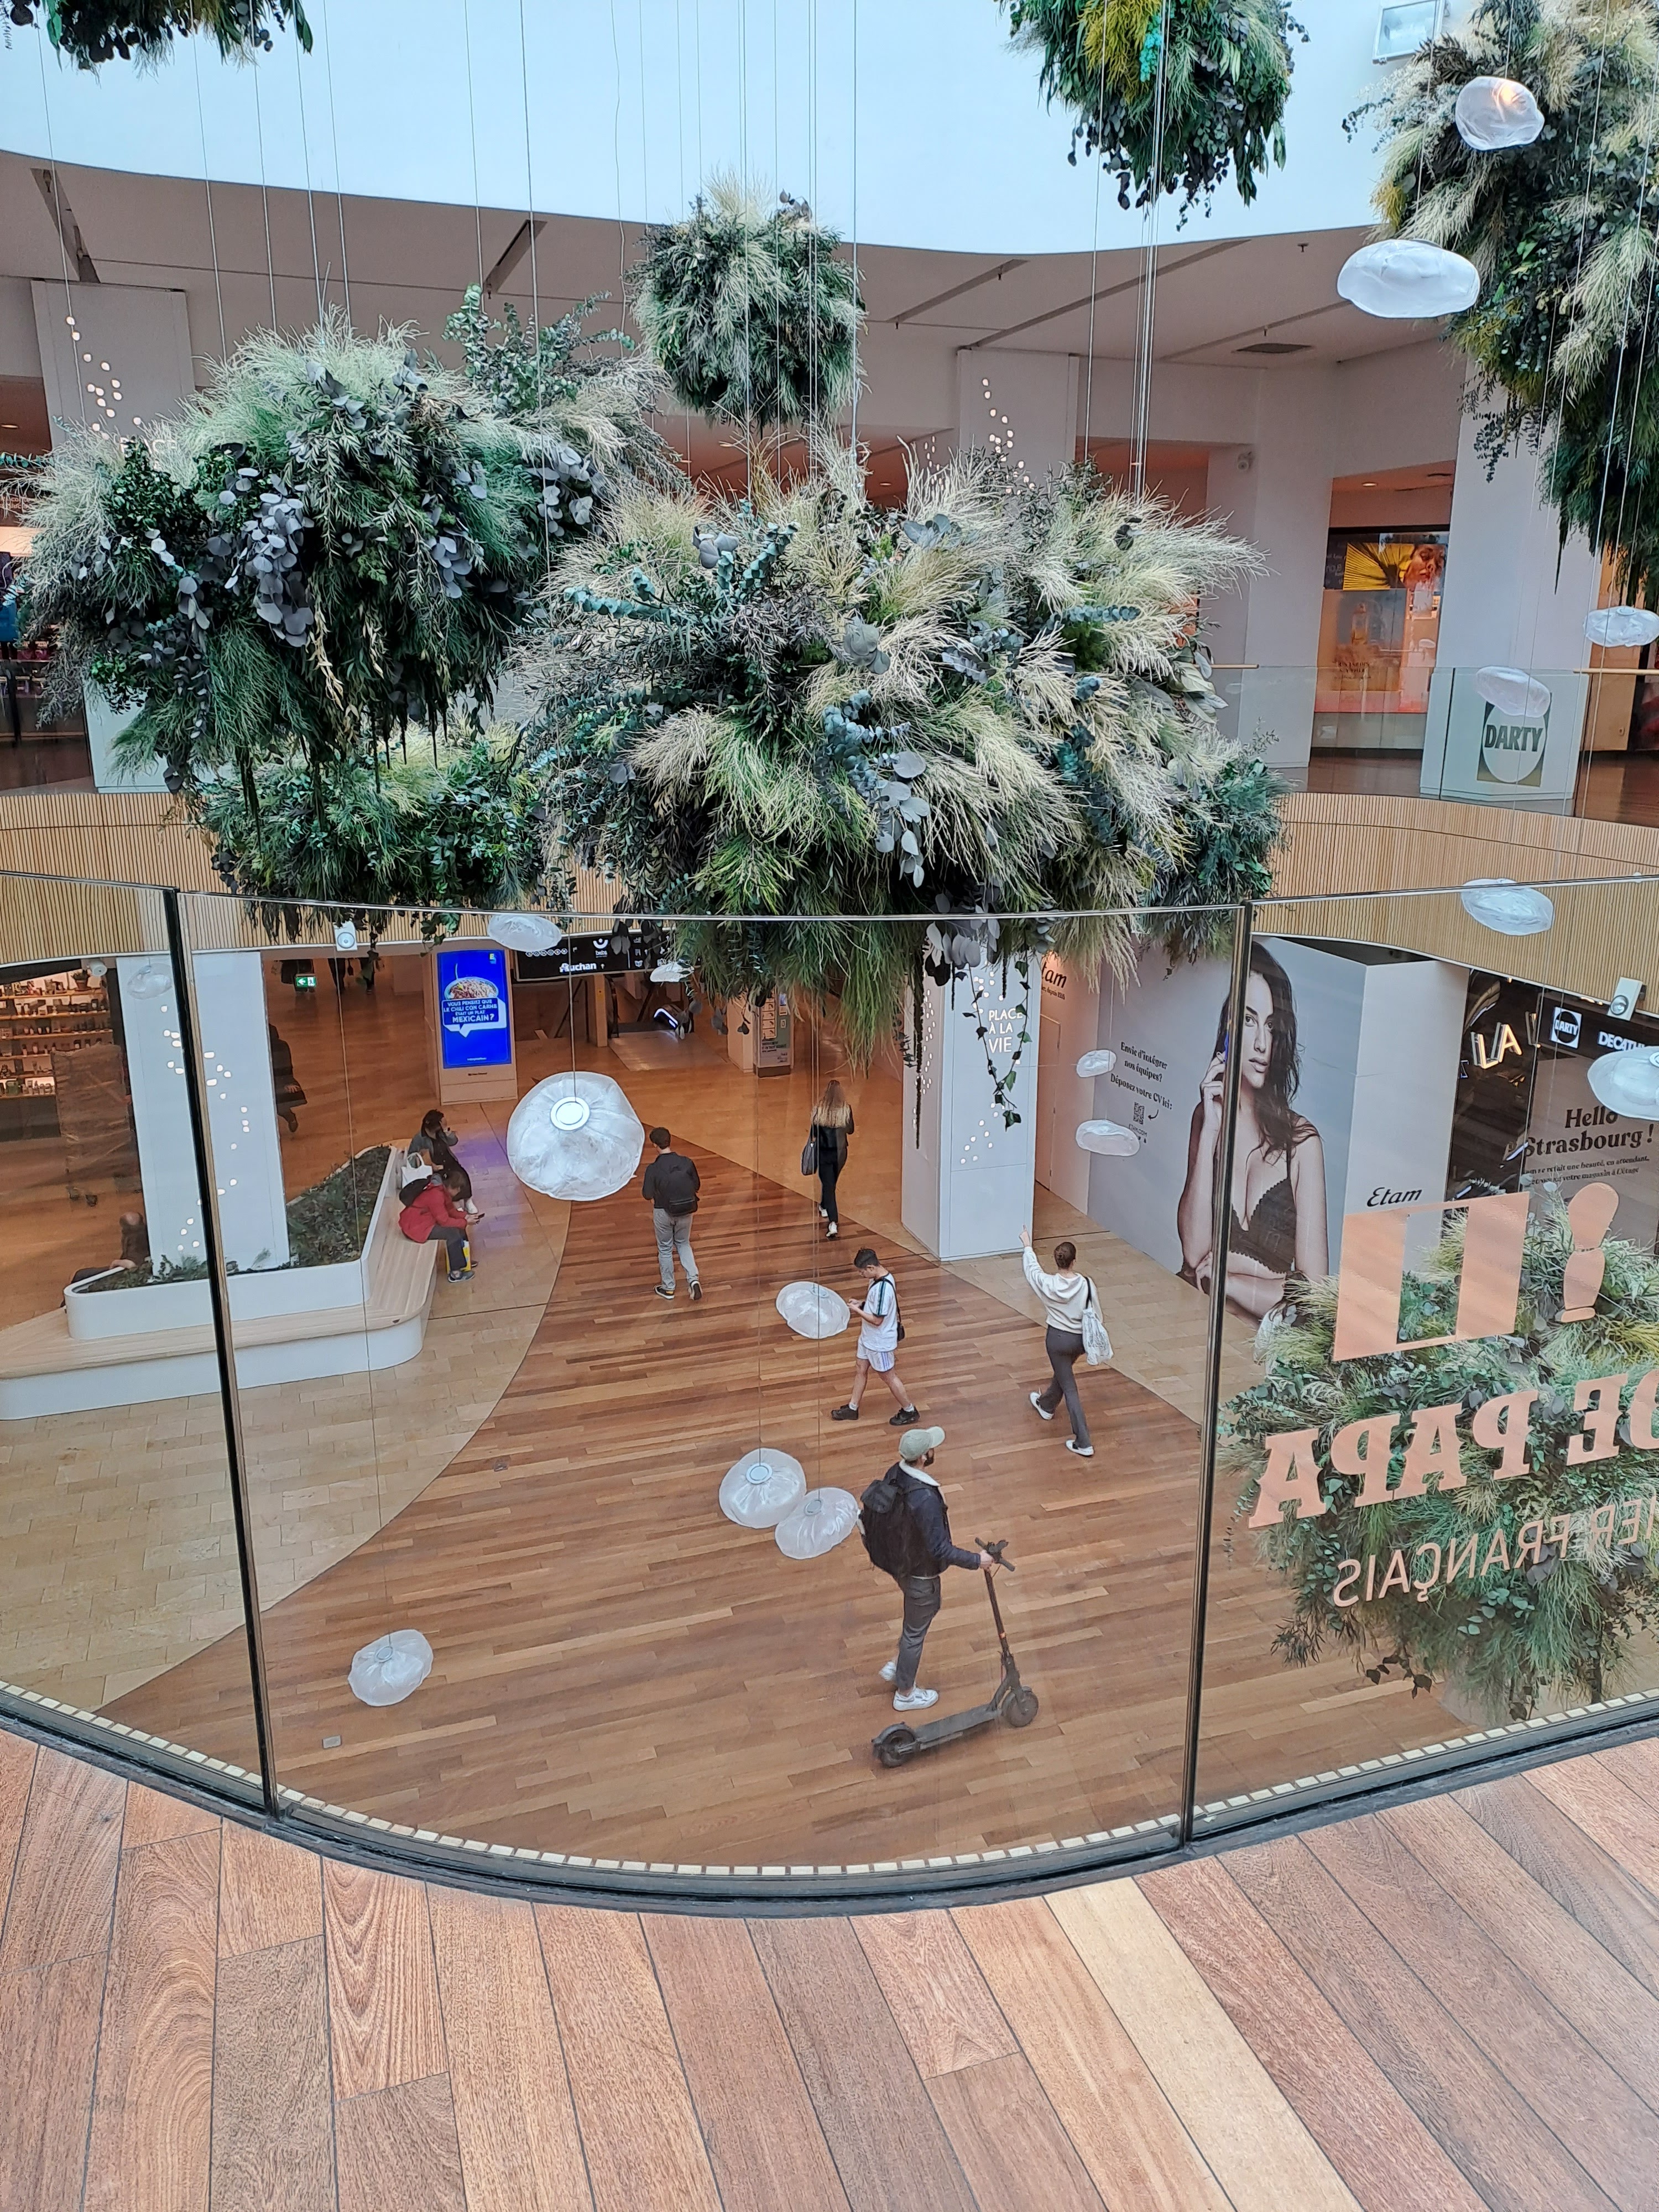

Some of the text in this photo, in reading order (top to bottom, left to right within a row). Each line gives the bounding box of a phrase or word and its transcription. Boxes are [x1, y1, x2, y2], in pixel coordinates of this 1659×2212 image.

[1484, 724, 1543, 752] DARTY
[560, 962, 596, 973] Auchan
[1041, 962, 1067, 988] tam
[989, 1022, 1013, 1035] À LA
[1554, 1019, 1579, 1035] DARTY
[988, 1037, 1012, 1053] VIE
[1121, 1041, 1137, 1057] Envie
[1124, 1060, 1135, 1070] nos
[1110, 1073, 1135, 1092] Déposez
[1136, 1087, 1152, 1099] votre
[1153, 1093, 1162, 1103] CV
[1565, 1106, 1618, 1128] Hello
[1582, 1169, 1610, 1179] magasin
[1366, 1187, 1422, 1207] Etam
